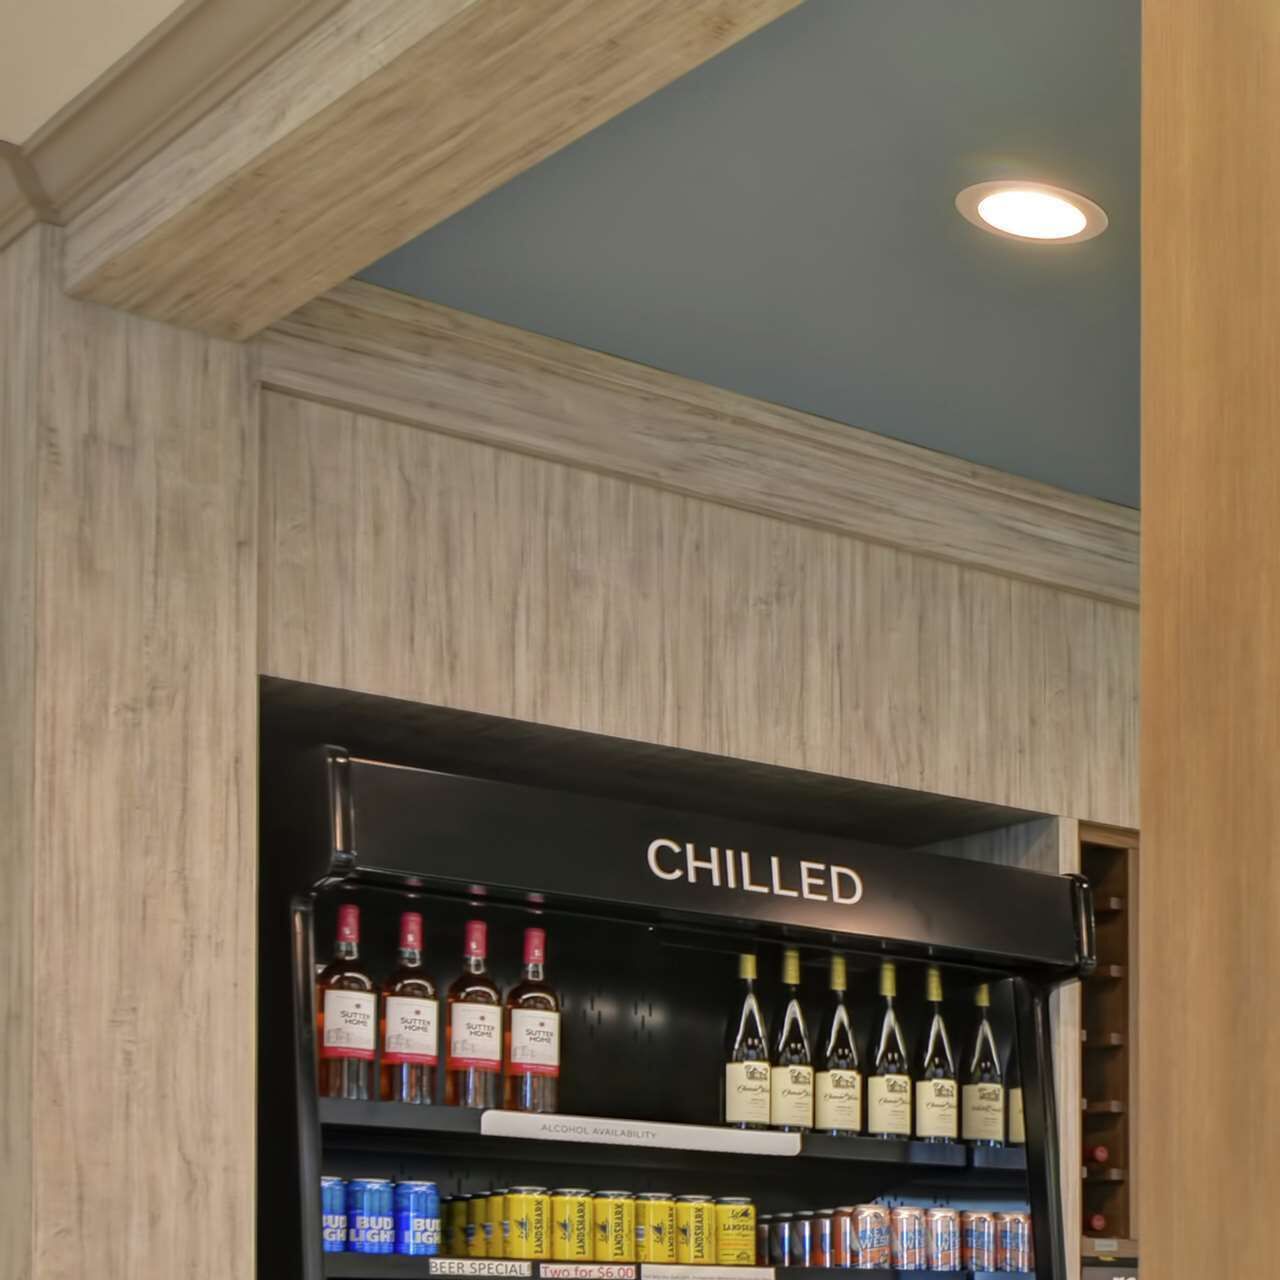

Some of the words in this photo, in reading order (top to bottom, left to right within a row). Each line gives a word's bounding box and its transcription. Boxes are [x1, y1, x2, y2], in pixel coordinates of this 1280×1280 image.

[647, 838, 863, 905] CHILLED
[541, 1123, 589, 1135] ALCOHOL
[592, 1127, 657, 1139] AVAILABILITY
[356, 1215, 395, 1230] BUD
[430, 1261, 465, 1275] BEER
[541, 1265, 569, 1279] Two
[571, 1263, 594, 1278] for
